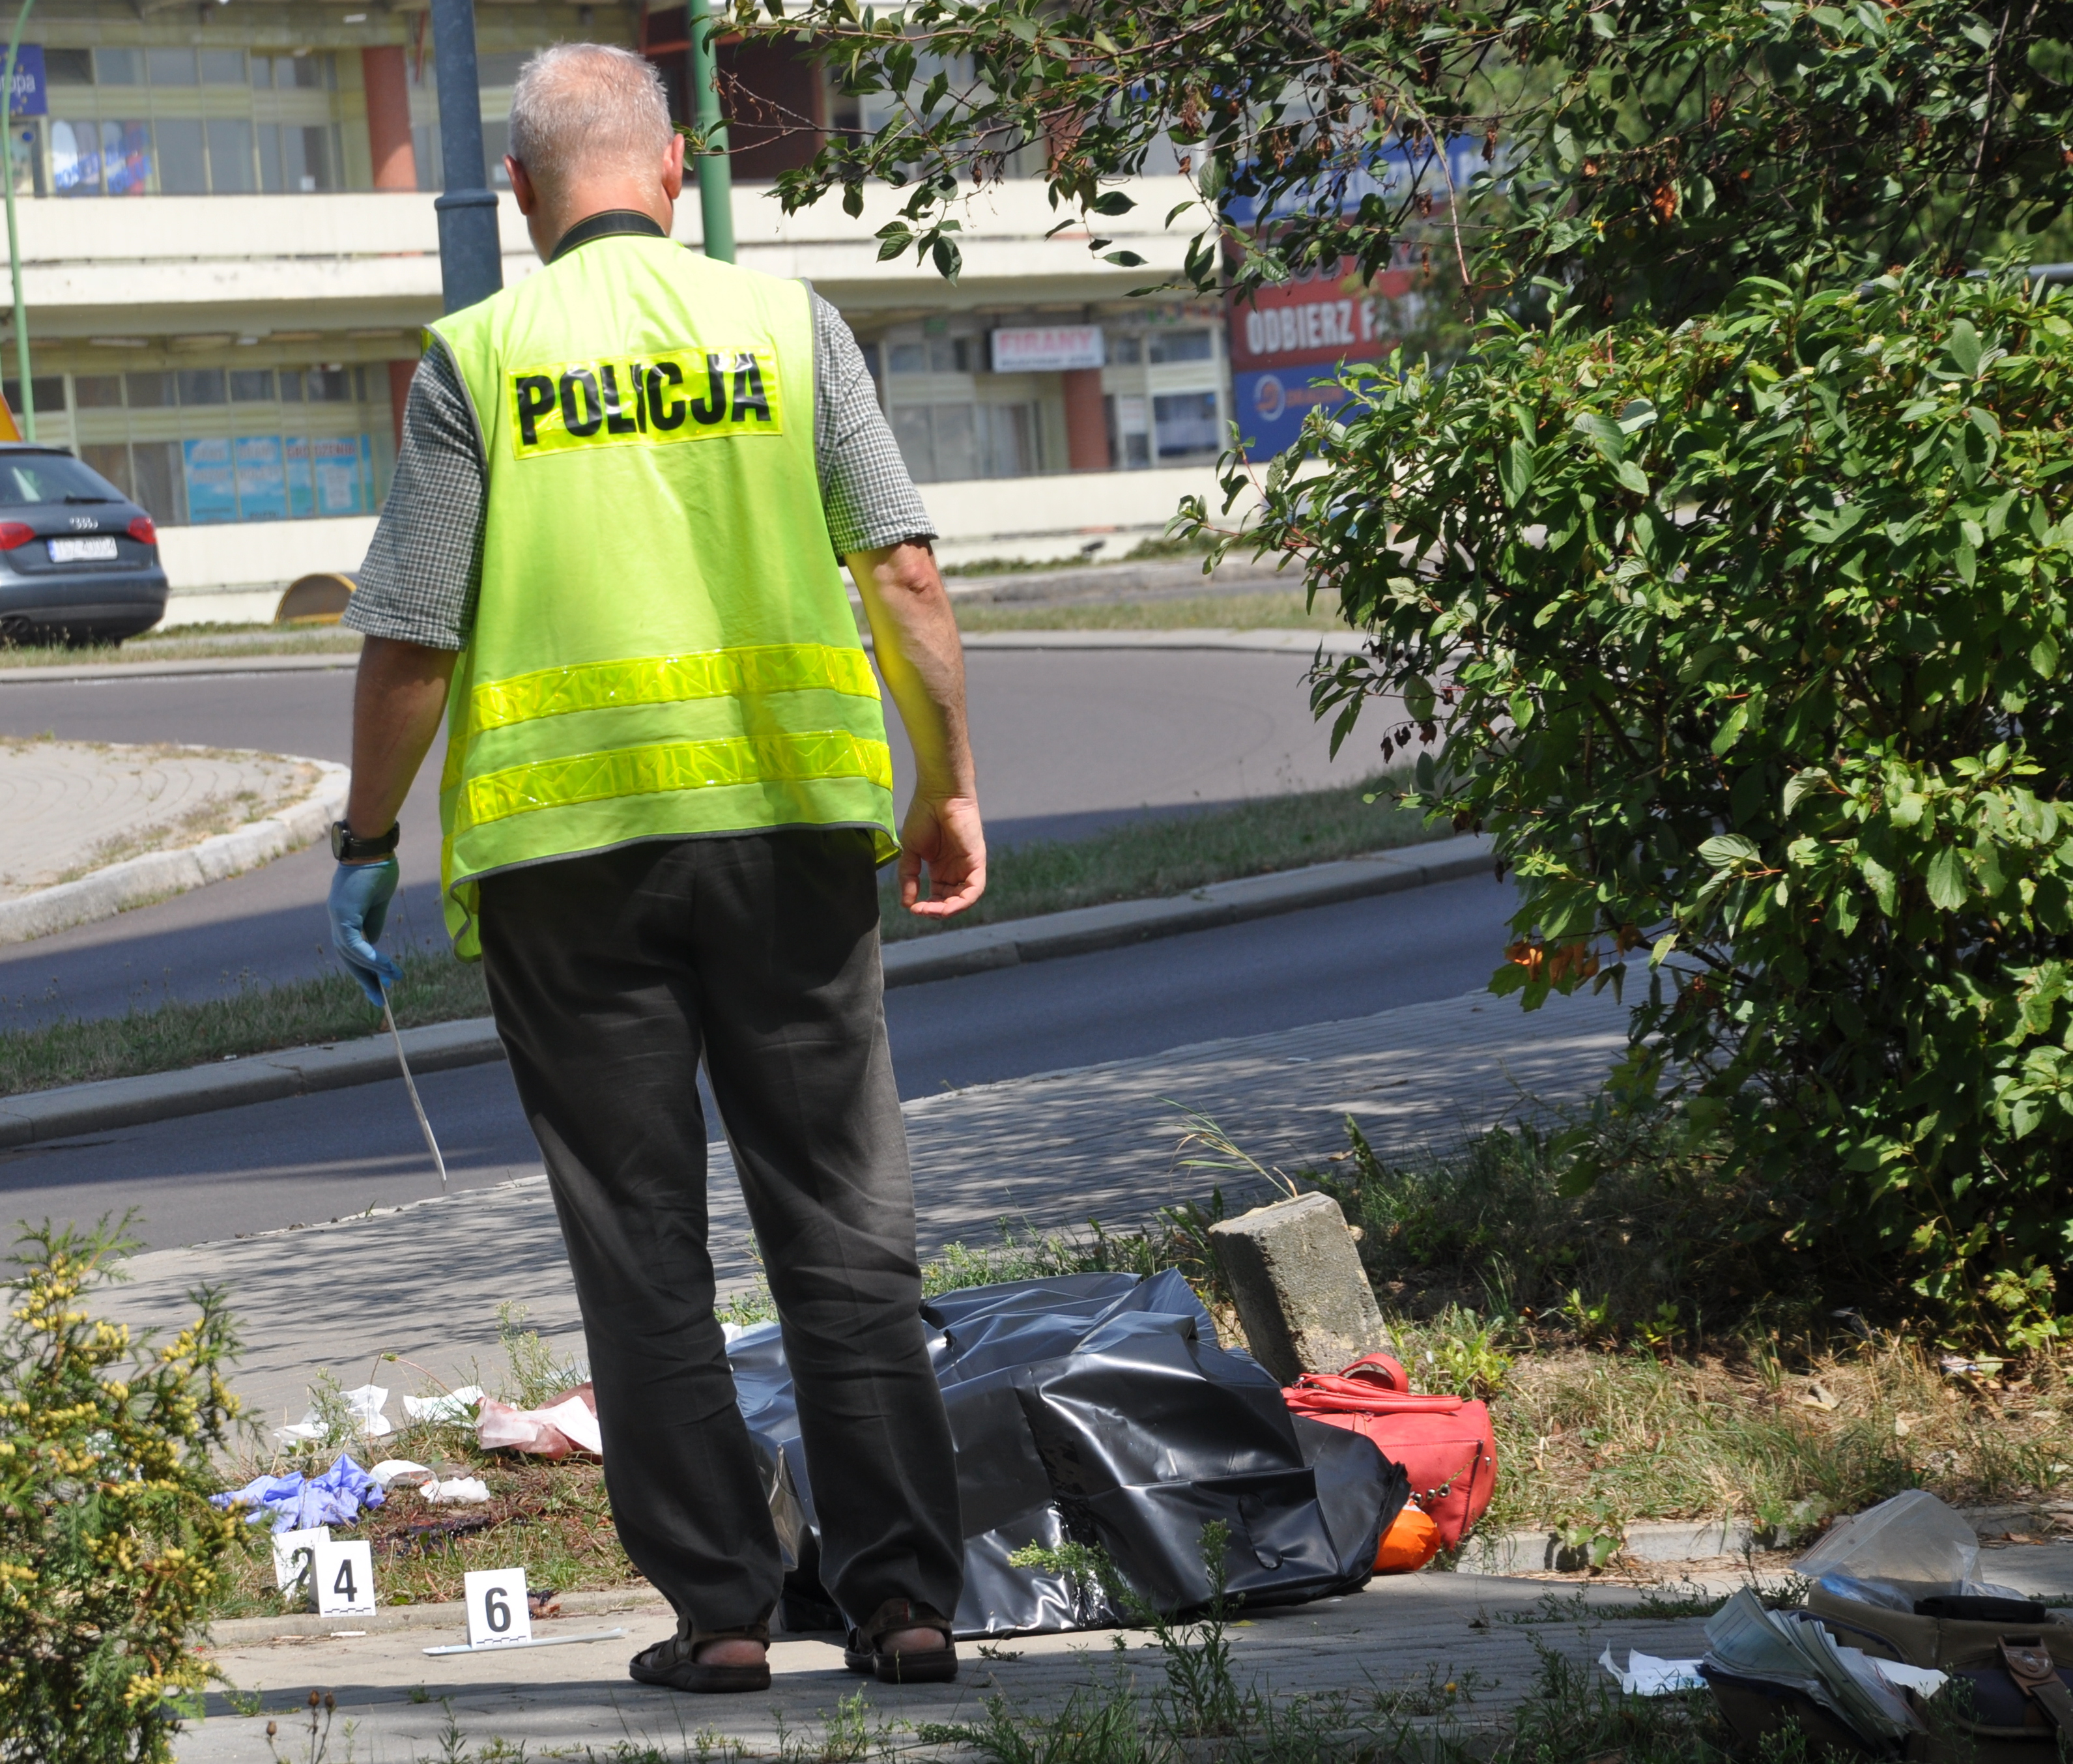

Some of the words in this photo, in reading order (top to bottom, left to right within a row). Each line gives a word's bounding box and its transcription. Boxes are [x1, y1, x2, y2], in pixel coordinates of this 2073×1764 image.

[999, 331, 1094, 354] FIRANY
[1246, 298, 1355, 355] ODBIERZ
[515, 353, 772, 446] POLICJA
[334, 1559, 358, 1603] 4
[485, 1587, 511, 1633] 6
